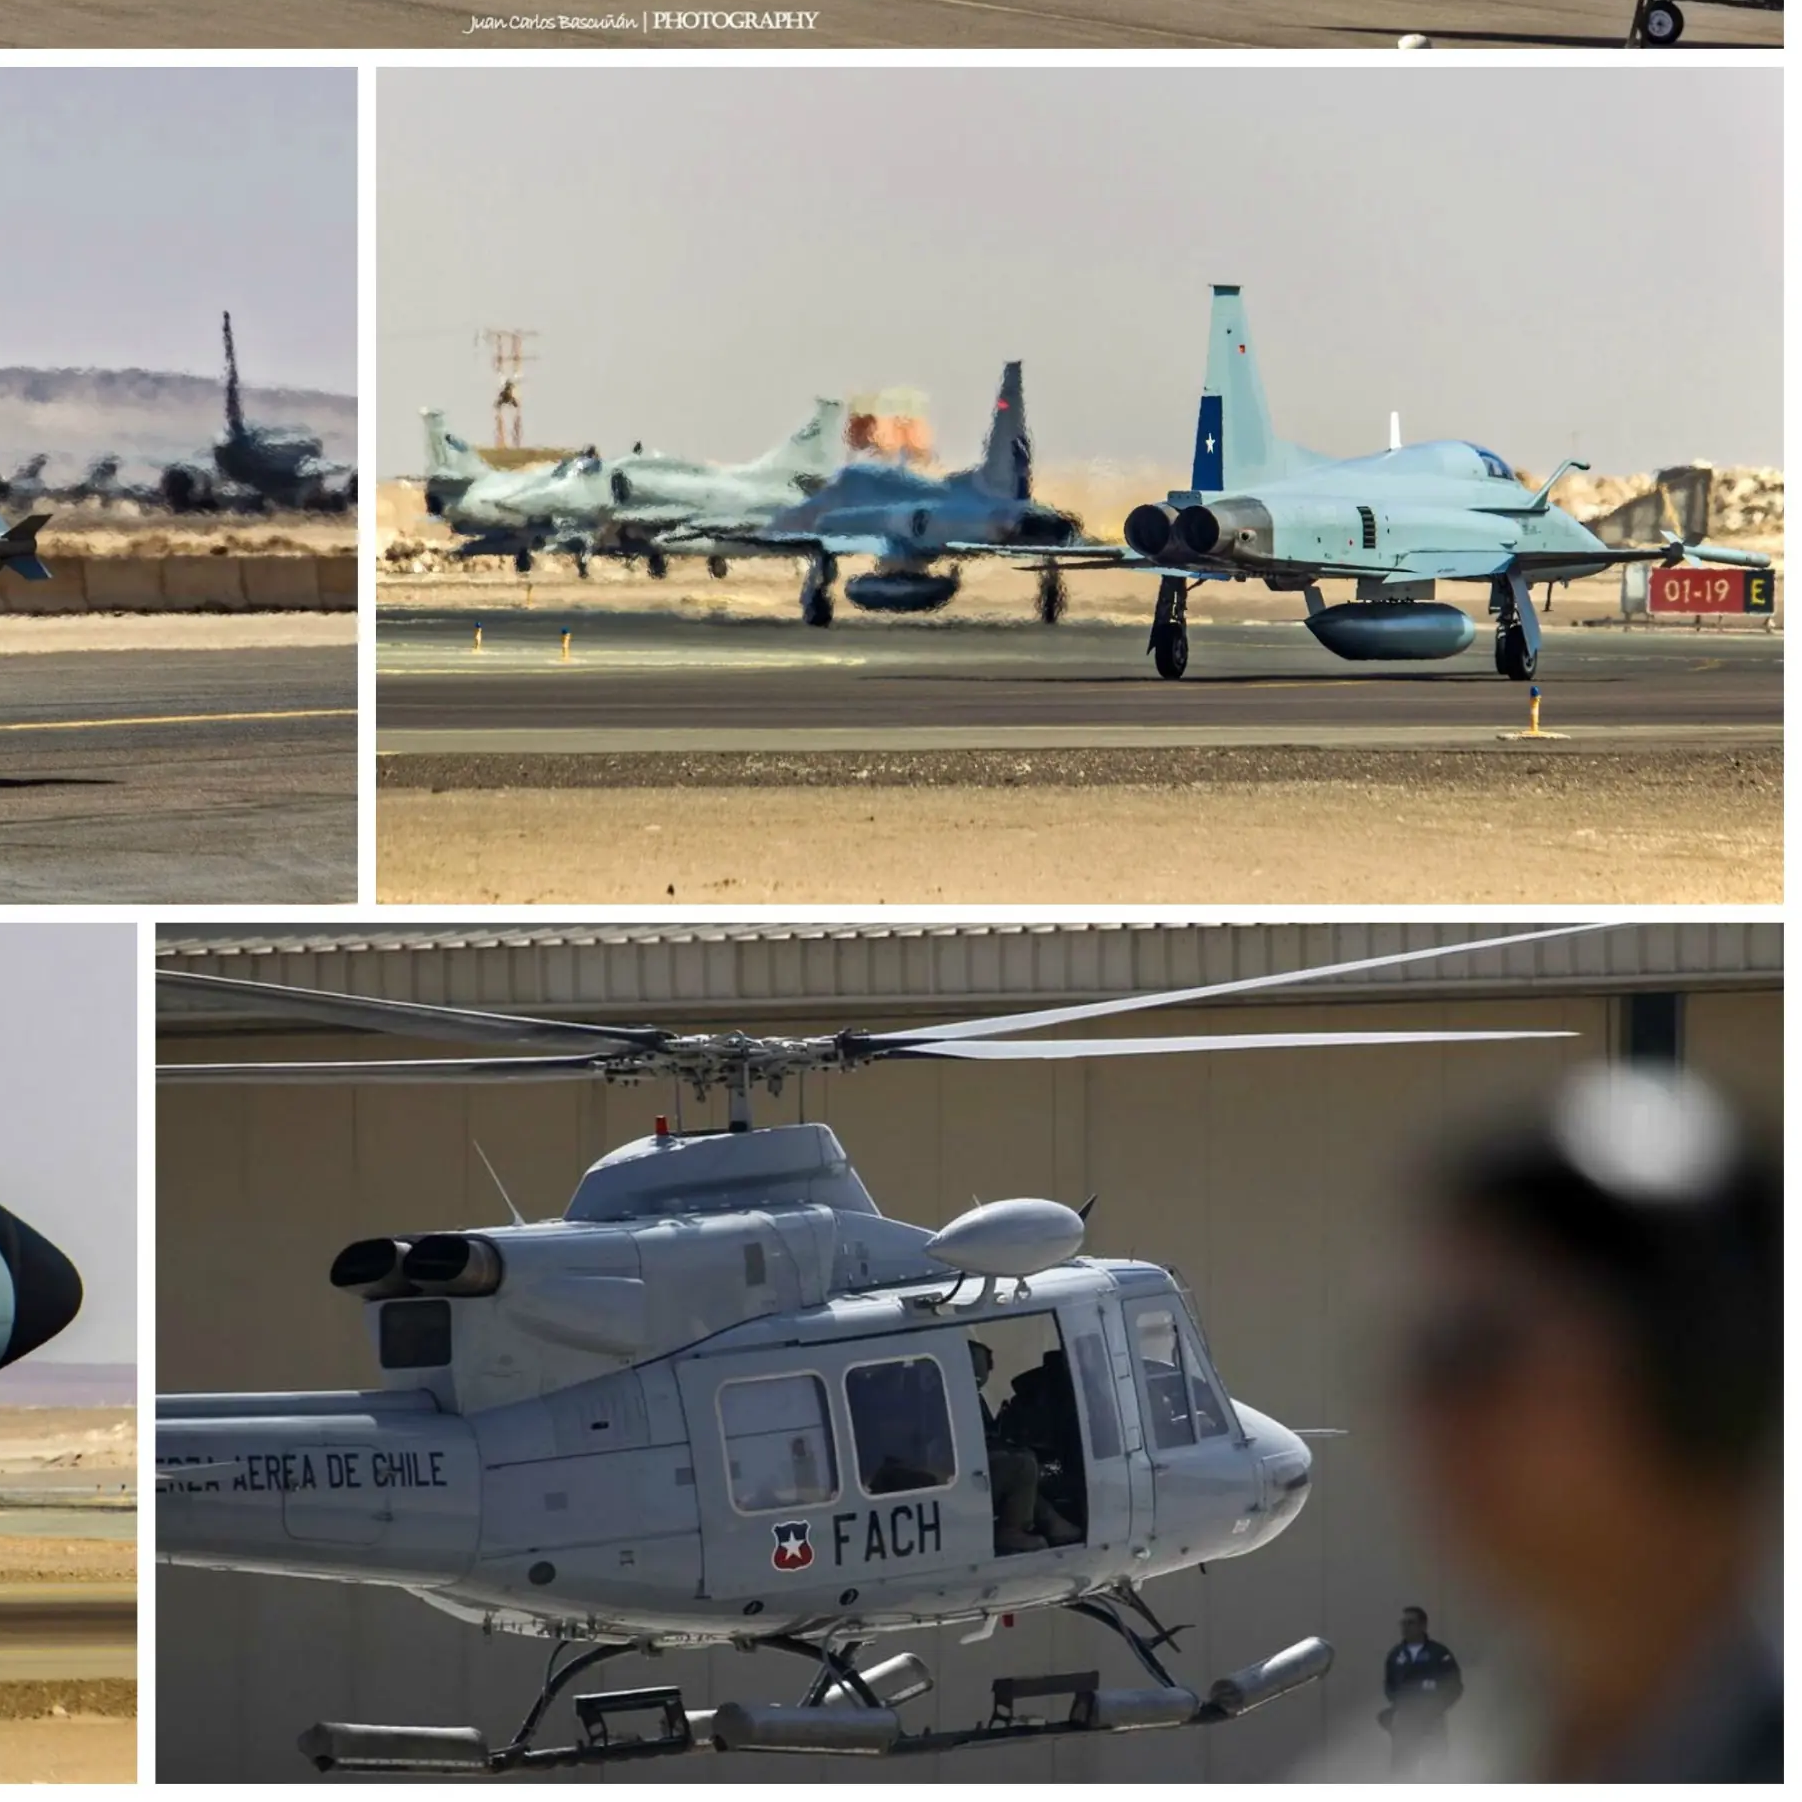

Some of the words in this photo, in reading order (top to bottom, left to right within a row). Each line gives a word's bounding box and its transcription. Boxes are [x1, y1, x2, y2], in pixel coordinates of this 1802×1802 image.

[1664, 579, 1730, 603] 01-19
[1751, 579, 1766, 604] E
[326, 1452, 363, 1489] DE
[372, 1451, 448, 1488] CHILE
[832, 1500, 942, 1566] FACH
